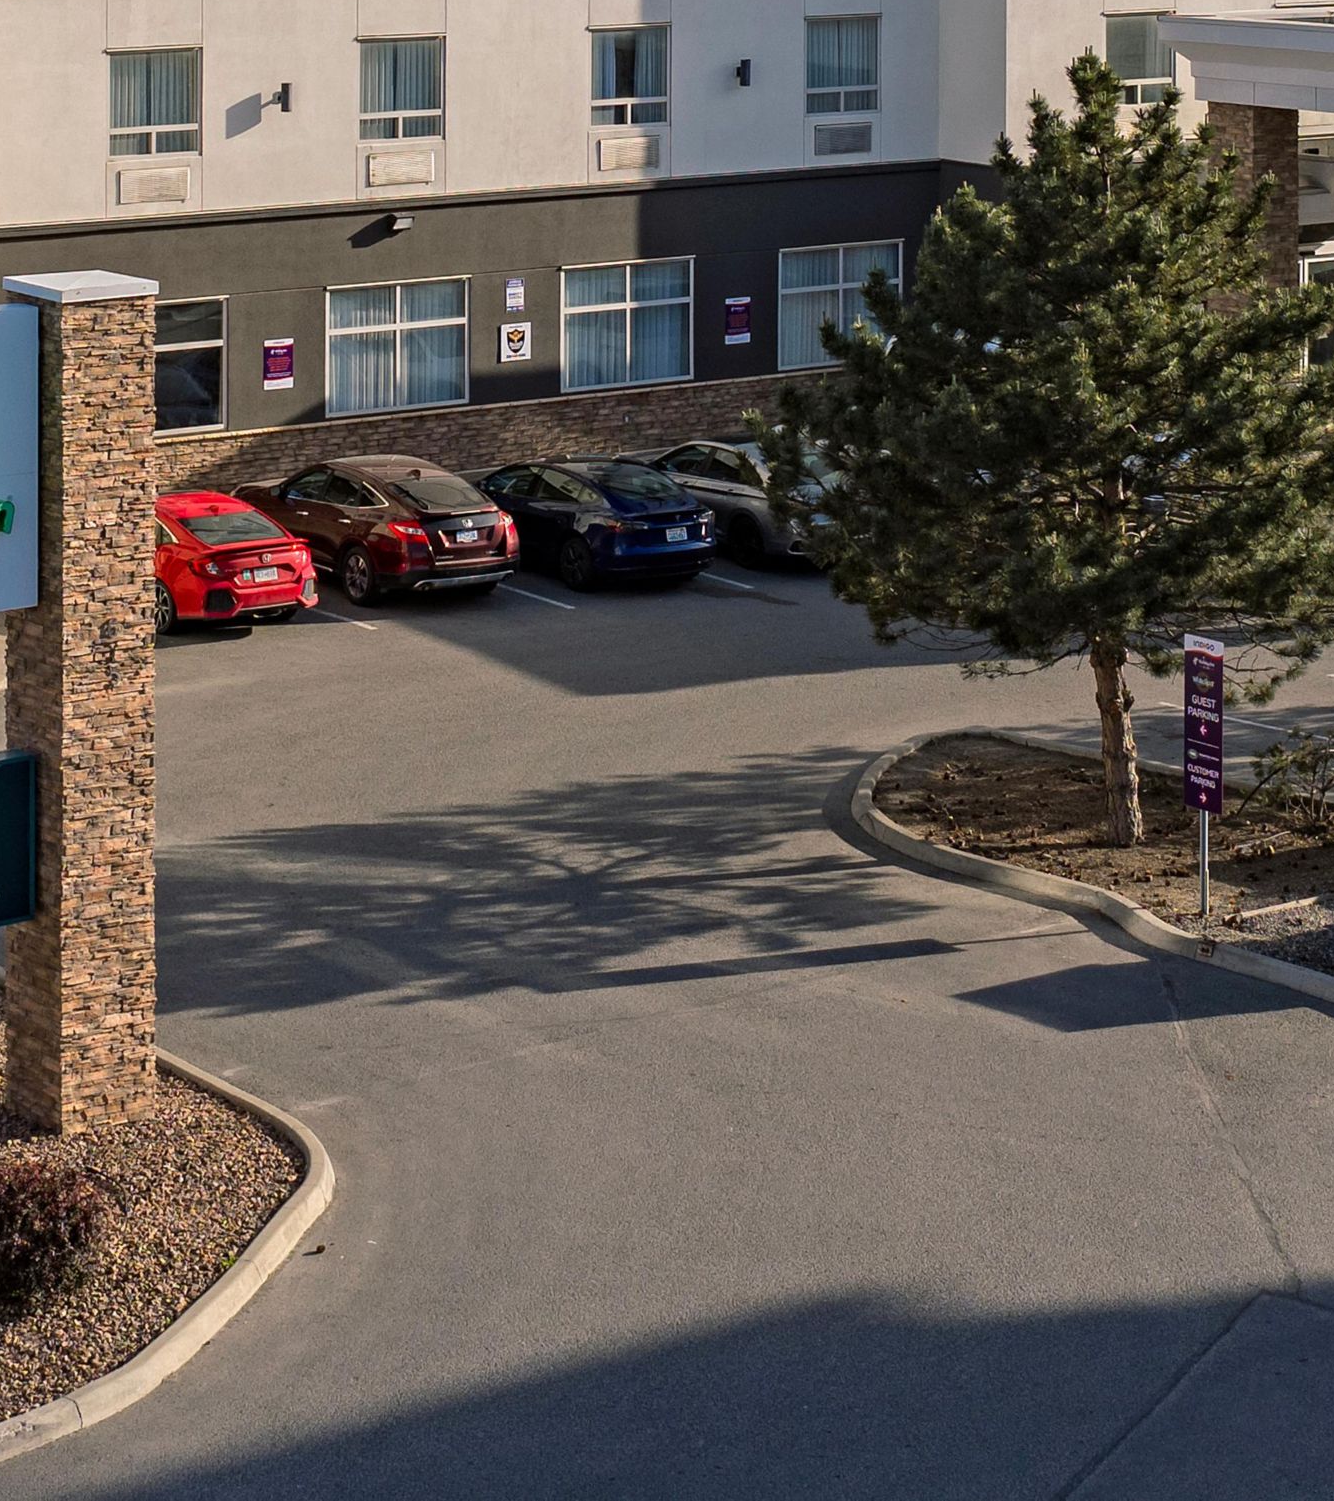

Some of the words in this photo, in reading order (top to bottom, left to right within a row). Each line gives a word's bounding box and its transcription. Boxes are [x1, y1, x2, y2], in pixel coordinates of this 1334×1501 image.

[1191, 694, 1217, 709] GUEST
[1187, 705, 1220, 723] PARKING
[1186, 763, 1220, 779] CUSTOMER
[1190, 774, 1217, 790] PARKING
